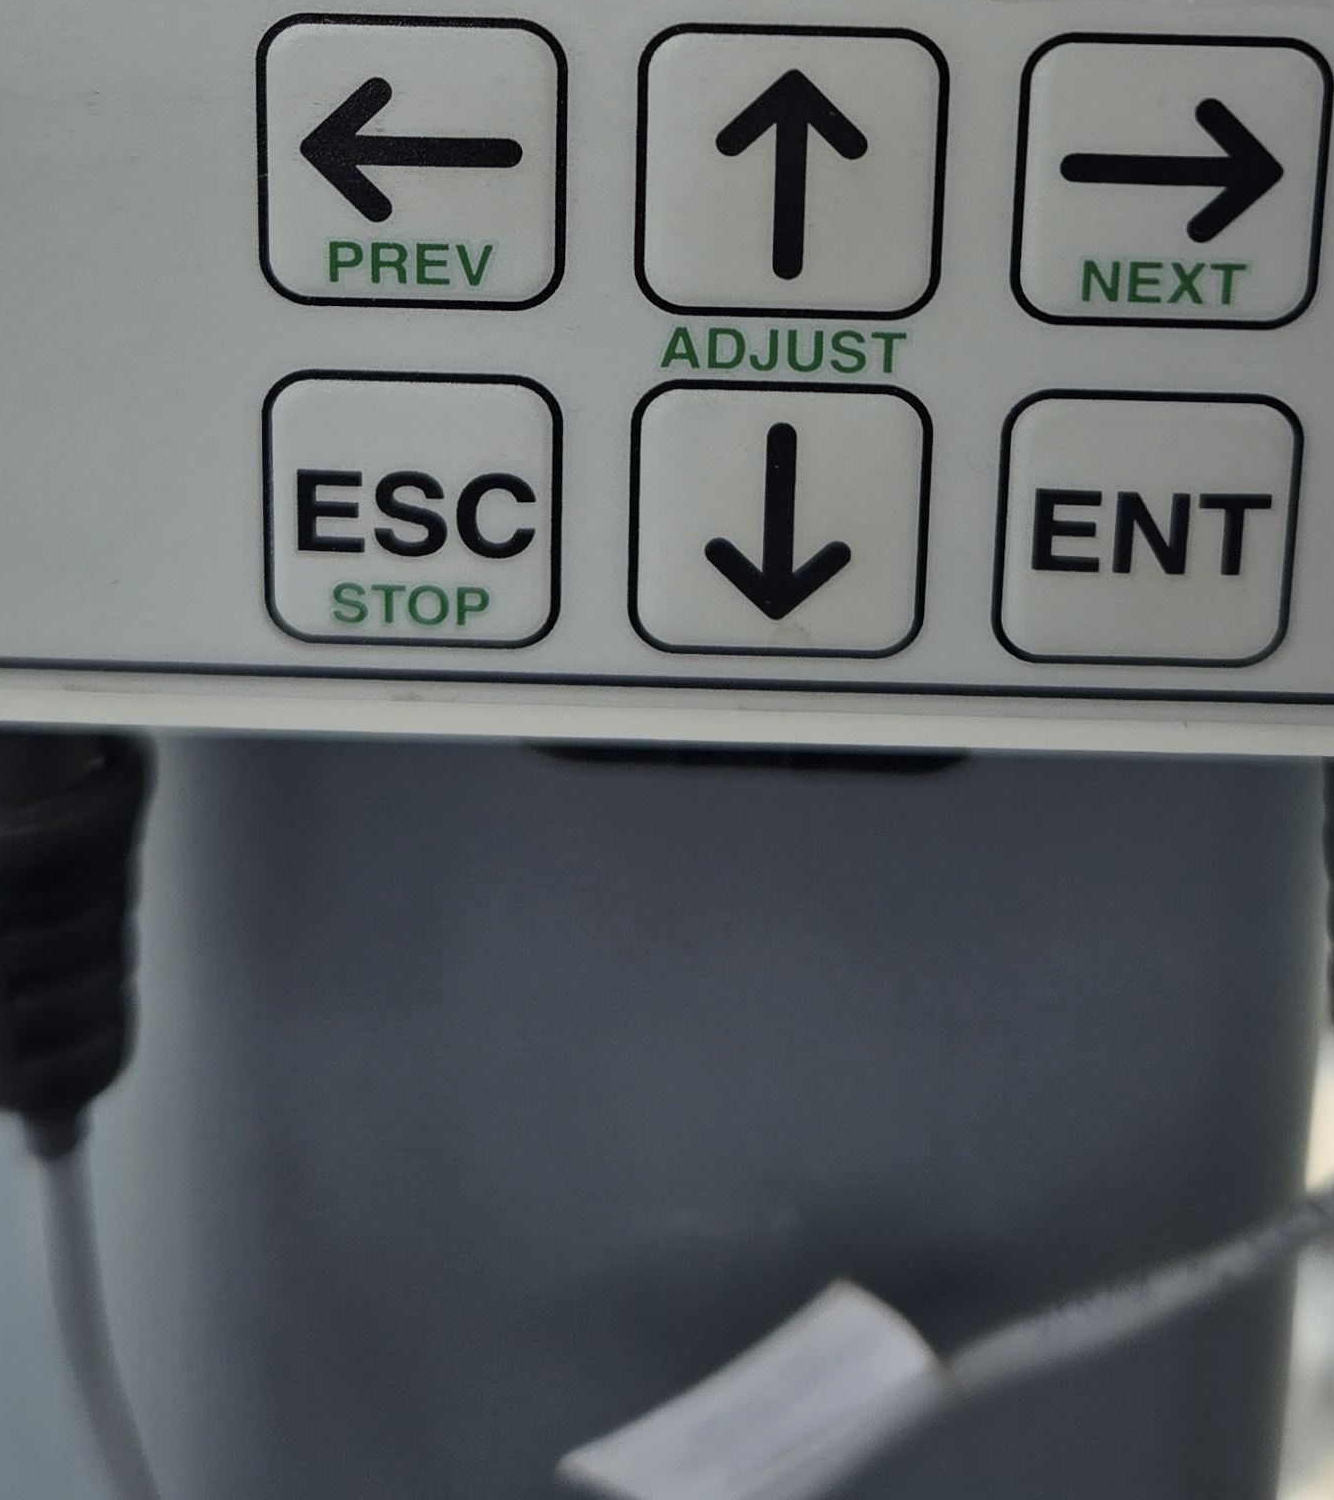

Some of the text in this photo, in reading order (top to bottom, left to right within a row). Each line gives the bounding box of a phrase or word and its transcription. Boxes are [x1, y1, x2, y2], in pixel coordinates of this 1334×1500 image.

[326, 239, 494, 287] PREV
[1080, 259, 1248, 306] NEXT
[659, 326, 908, 375] ADJUST
[295, 468, 538, 558] ESC
[1031, 488, 1273, 576] ENT
[331, 583, 491, 626] STOP
